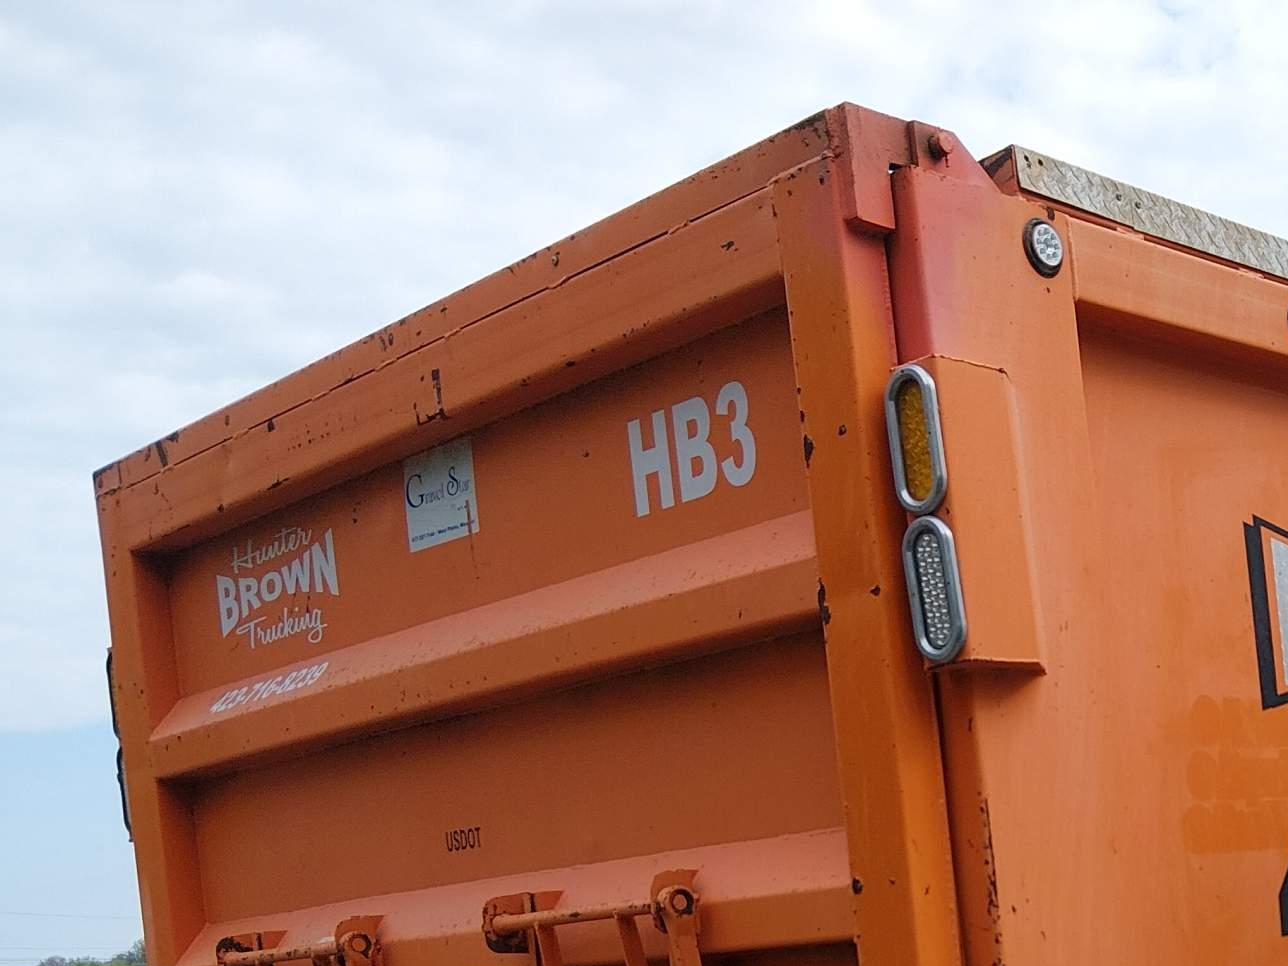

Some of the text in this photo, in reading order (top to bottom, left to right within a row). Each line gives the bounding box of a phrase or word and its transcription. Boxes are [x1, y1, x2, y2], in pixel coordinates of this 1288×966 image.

[626, 380, 757, 518] HB3
[230, 526, 313, 574] Hunter
[216, 527, 340, 639] BROWN
[235, 607, 328, 649] Trucking
[209, 661, 329, 713] 423-716-8239
[445, 826, 481, 852] USDOT
